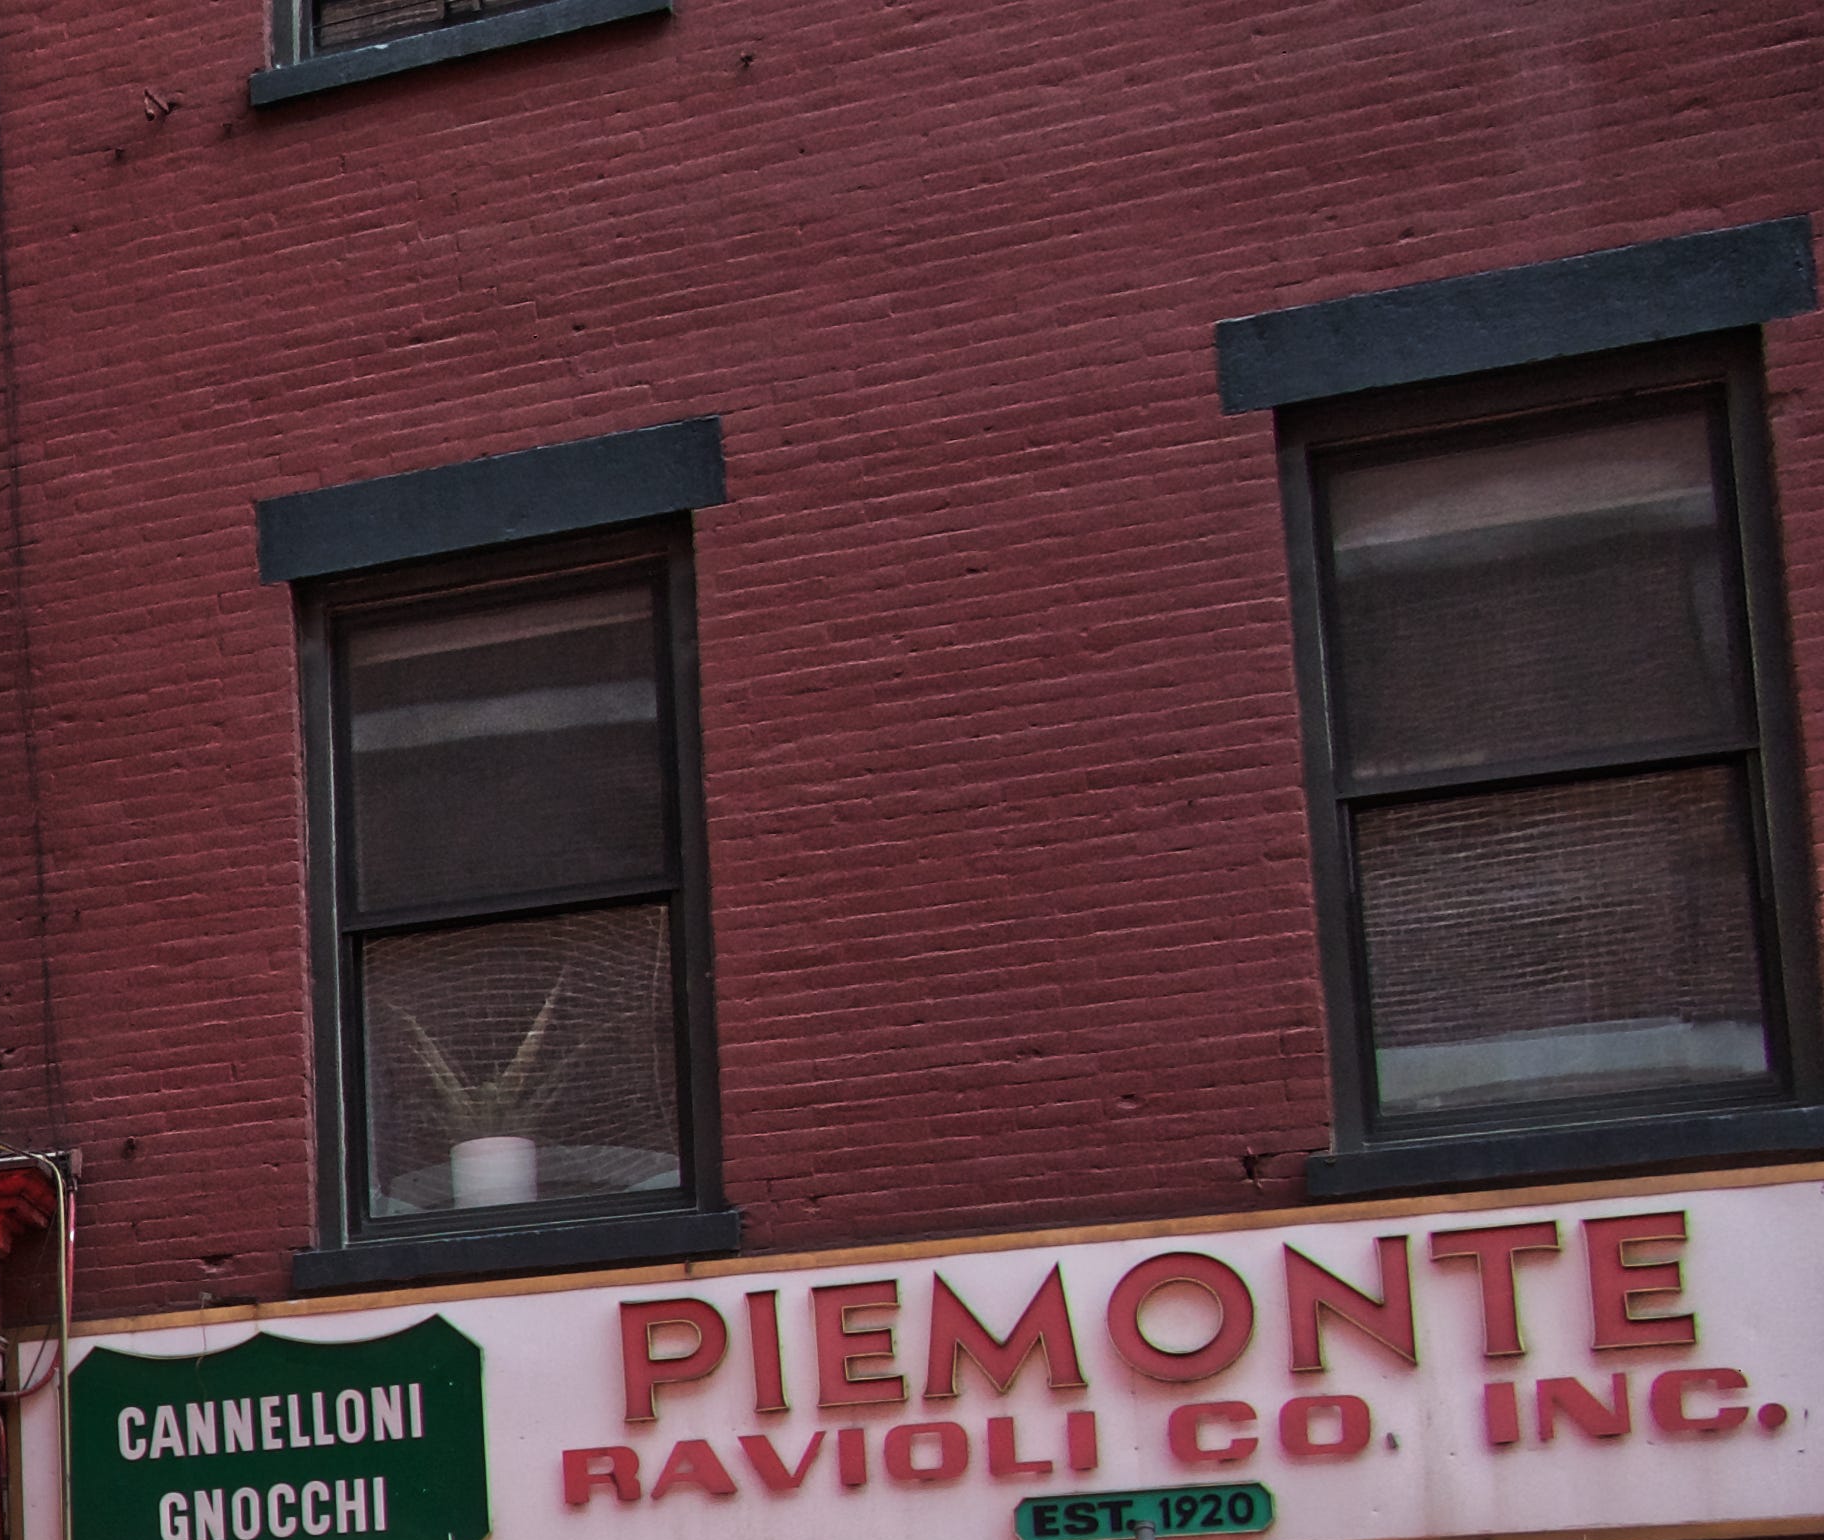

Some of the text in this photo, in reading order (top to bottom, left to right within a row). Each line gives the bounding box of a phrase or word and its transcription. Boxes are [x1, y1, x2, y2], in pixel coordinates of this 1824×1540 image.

[618, 1209, 1698, 1424] PIEMONTE
[117, 1383, 424, 1461] CANNELLONI
[561, 1410, 1099, 1507] RAVIOLI
[1485, 1366, 1789, 1446] INC.
[1031, 1490, 1255, 1537] EST. 1920
